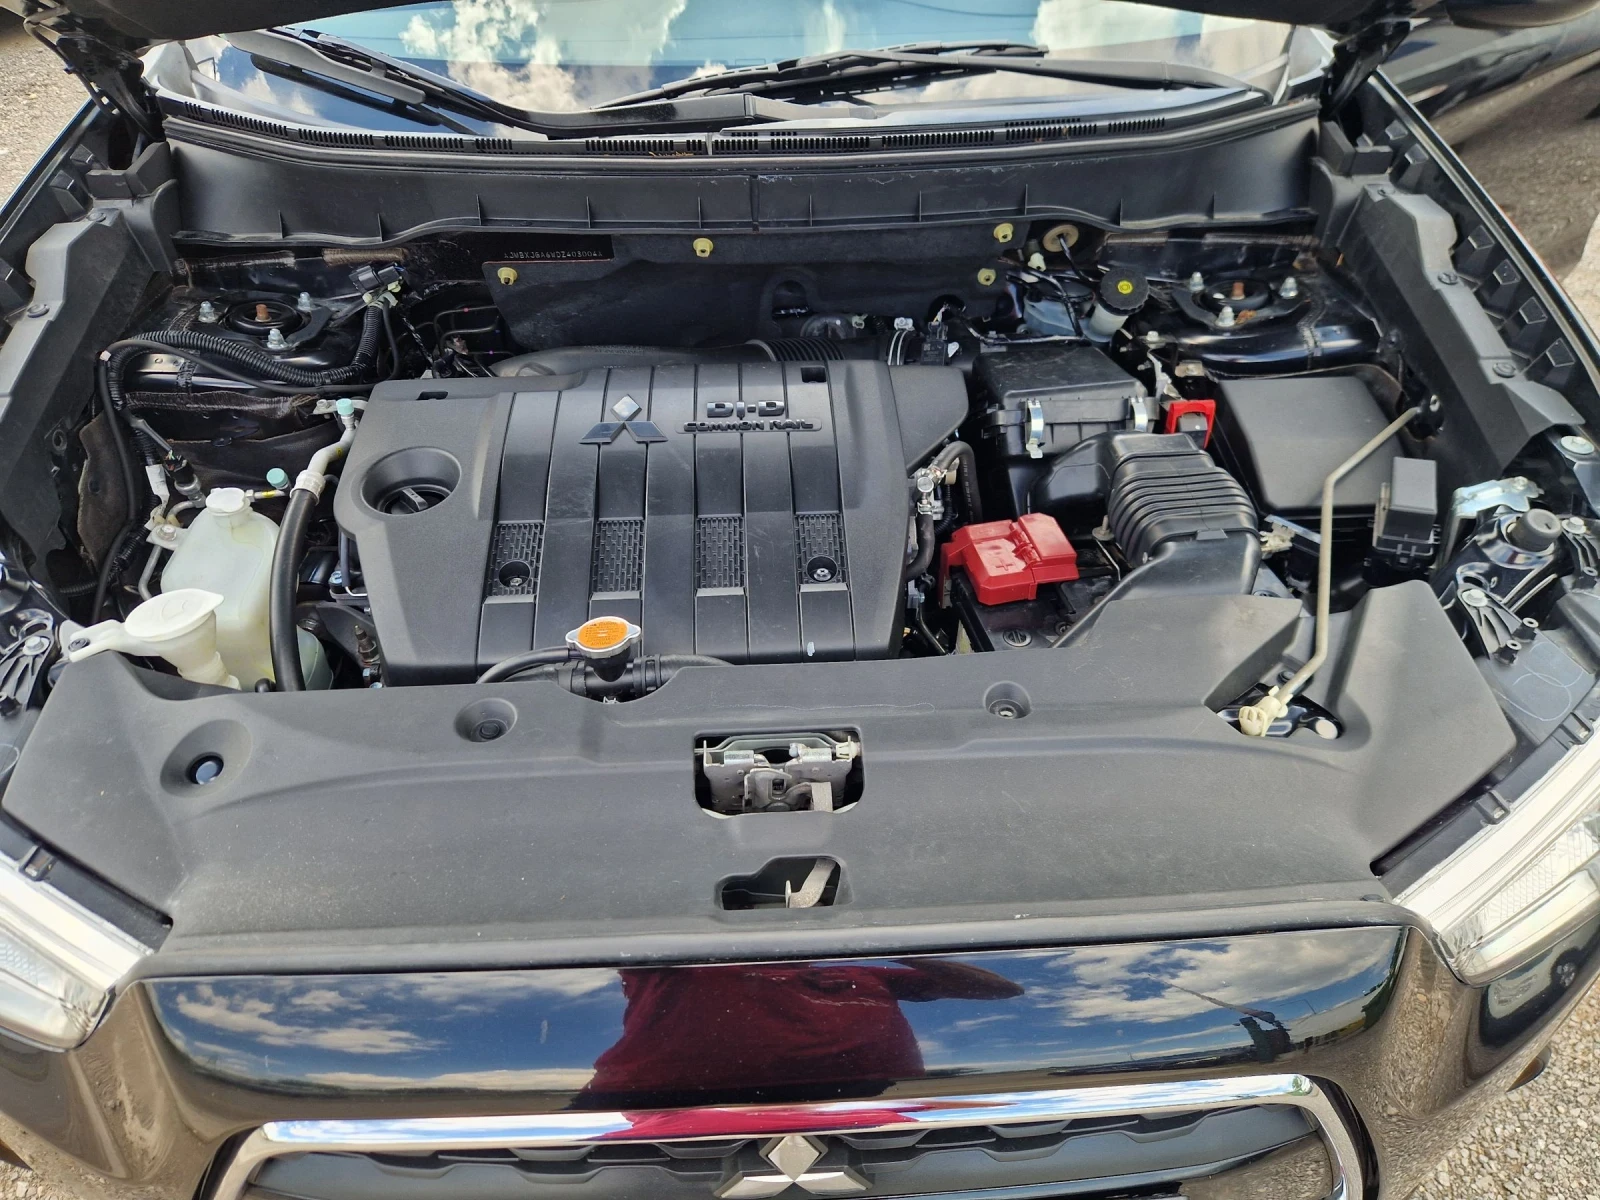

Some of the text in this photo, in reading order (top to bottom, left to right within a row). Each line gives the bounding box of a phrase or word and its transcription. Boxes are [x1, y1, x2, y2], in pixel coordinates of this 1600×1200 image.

[706, 401, 785, 418] DI-D
[683, 419, 814, 432] COMMON RAIL
